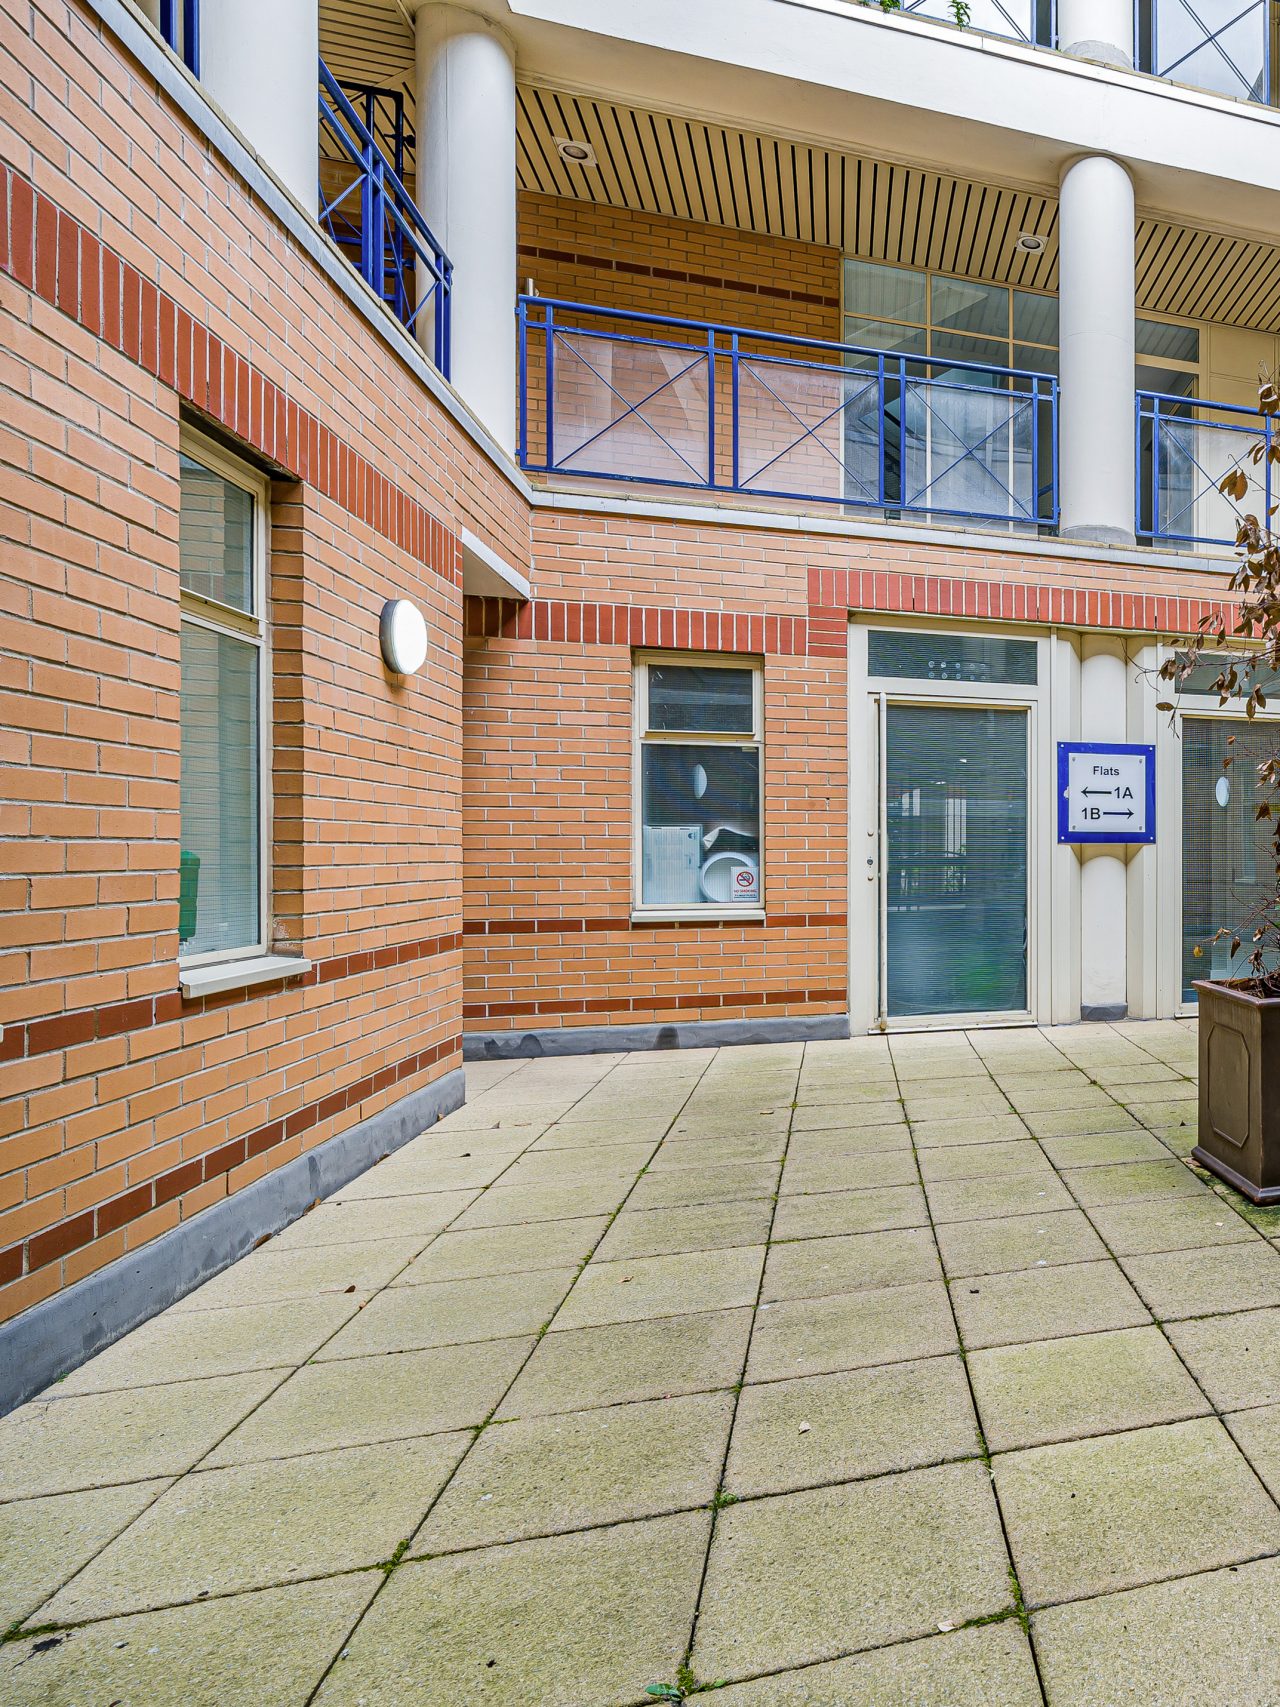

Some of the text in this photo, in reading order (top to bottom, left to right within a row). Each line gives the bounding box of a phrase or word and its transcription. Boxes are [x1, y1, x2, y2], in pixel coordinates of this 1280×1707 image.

[1093, 766, 1120, 776] Flats
[1114, 786, 1134, 799] 1A
[1081, 807, 1101, 820] 1B
